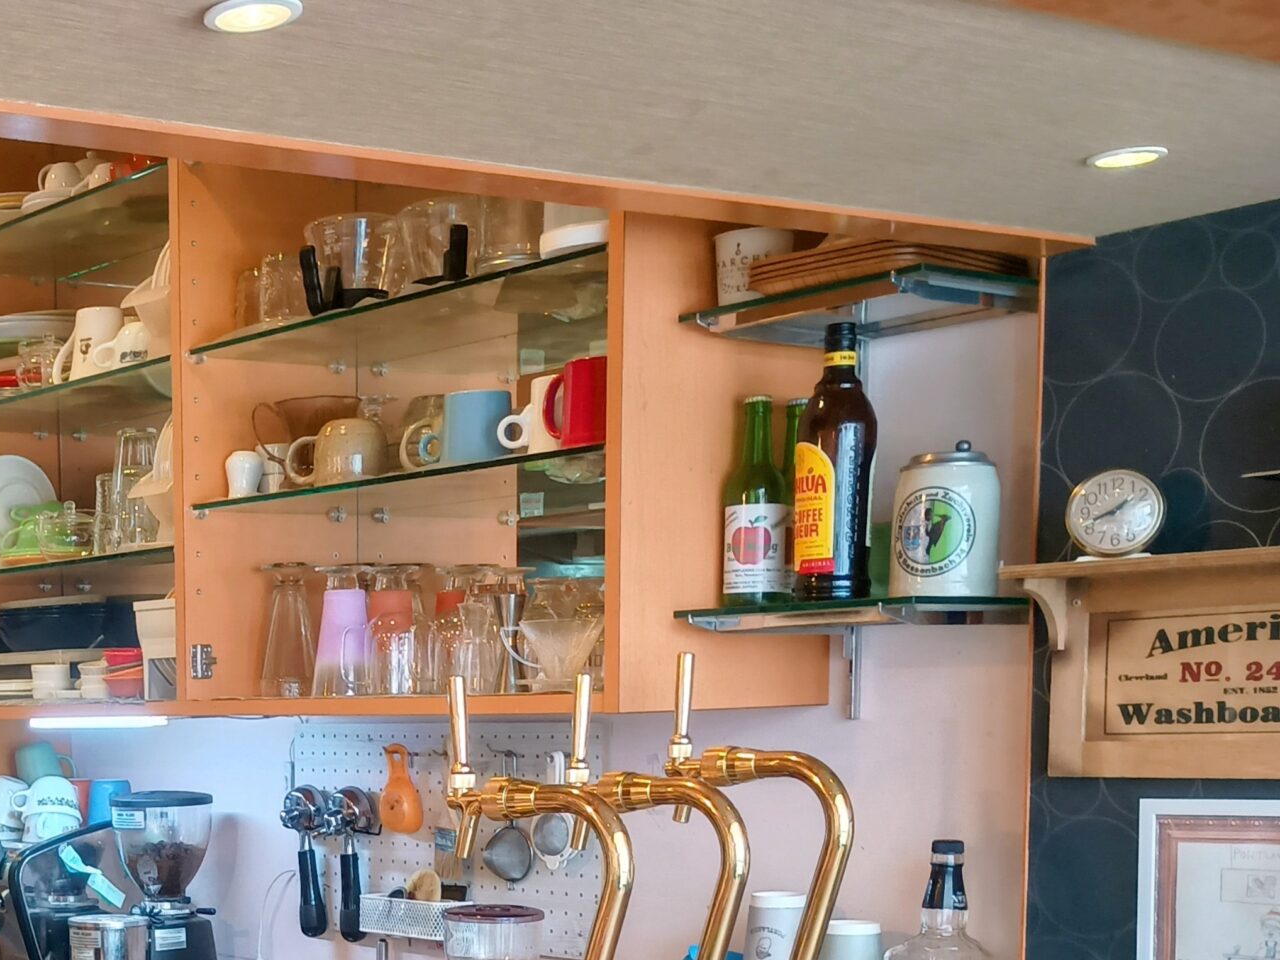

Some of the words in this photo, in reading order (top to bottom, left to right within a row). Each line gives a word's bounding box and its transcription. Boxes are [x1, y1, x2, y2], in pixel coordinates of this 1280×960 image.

[1097, 482, 1108, 495] 11
[1110, 477, 1125, 491] 12
[1131, 480, 1135, 494] 1
[1081, 492, 1098, 505] 10
[1139, 488, 1149, 500] 2
[1080, 506, 1090, 520] 9
[1097, 531, 1106, 544] 7
[1110, 534, 1120, 547] 6
[1118, 672, 1168, 682] Cleveland
